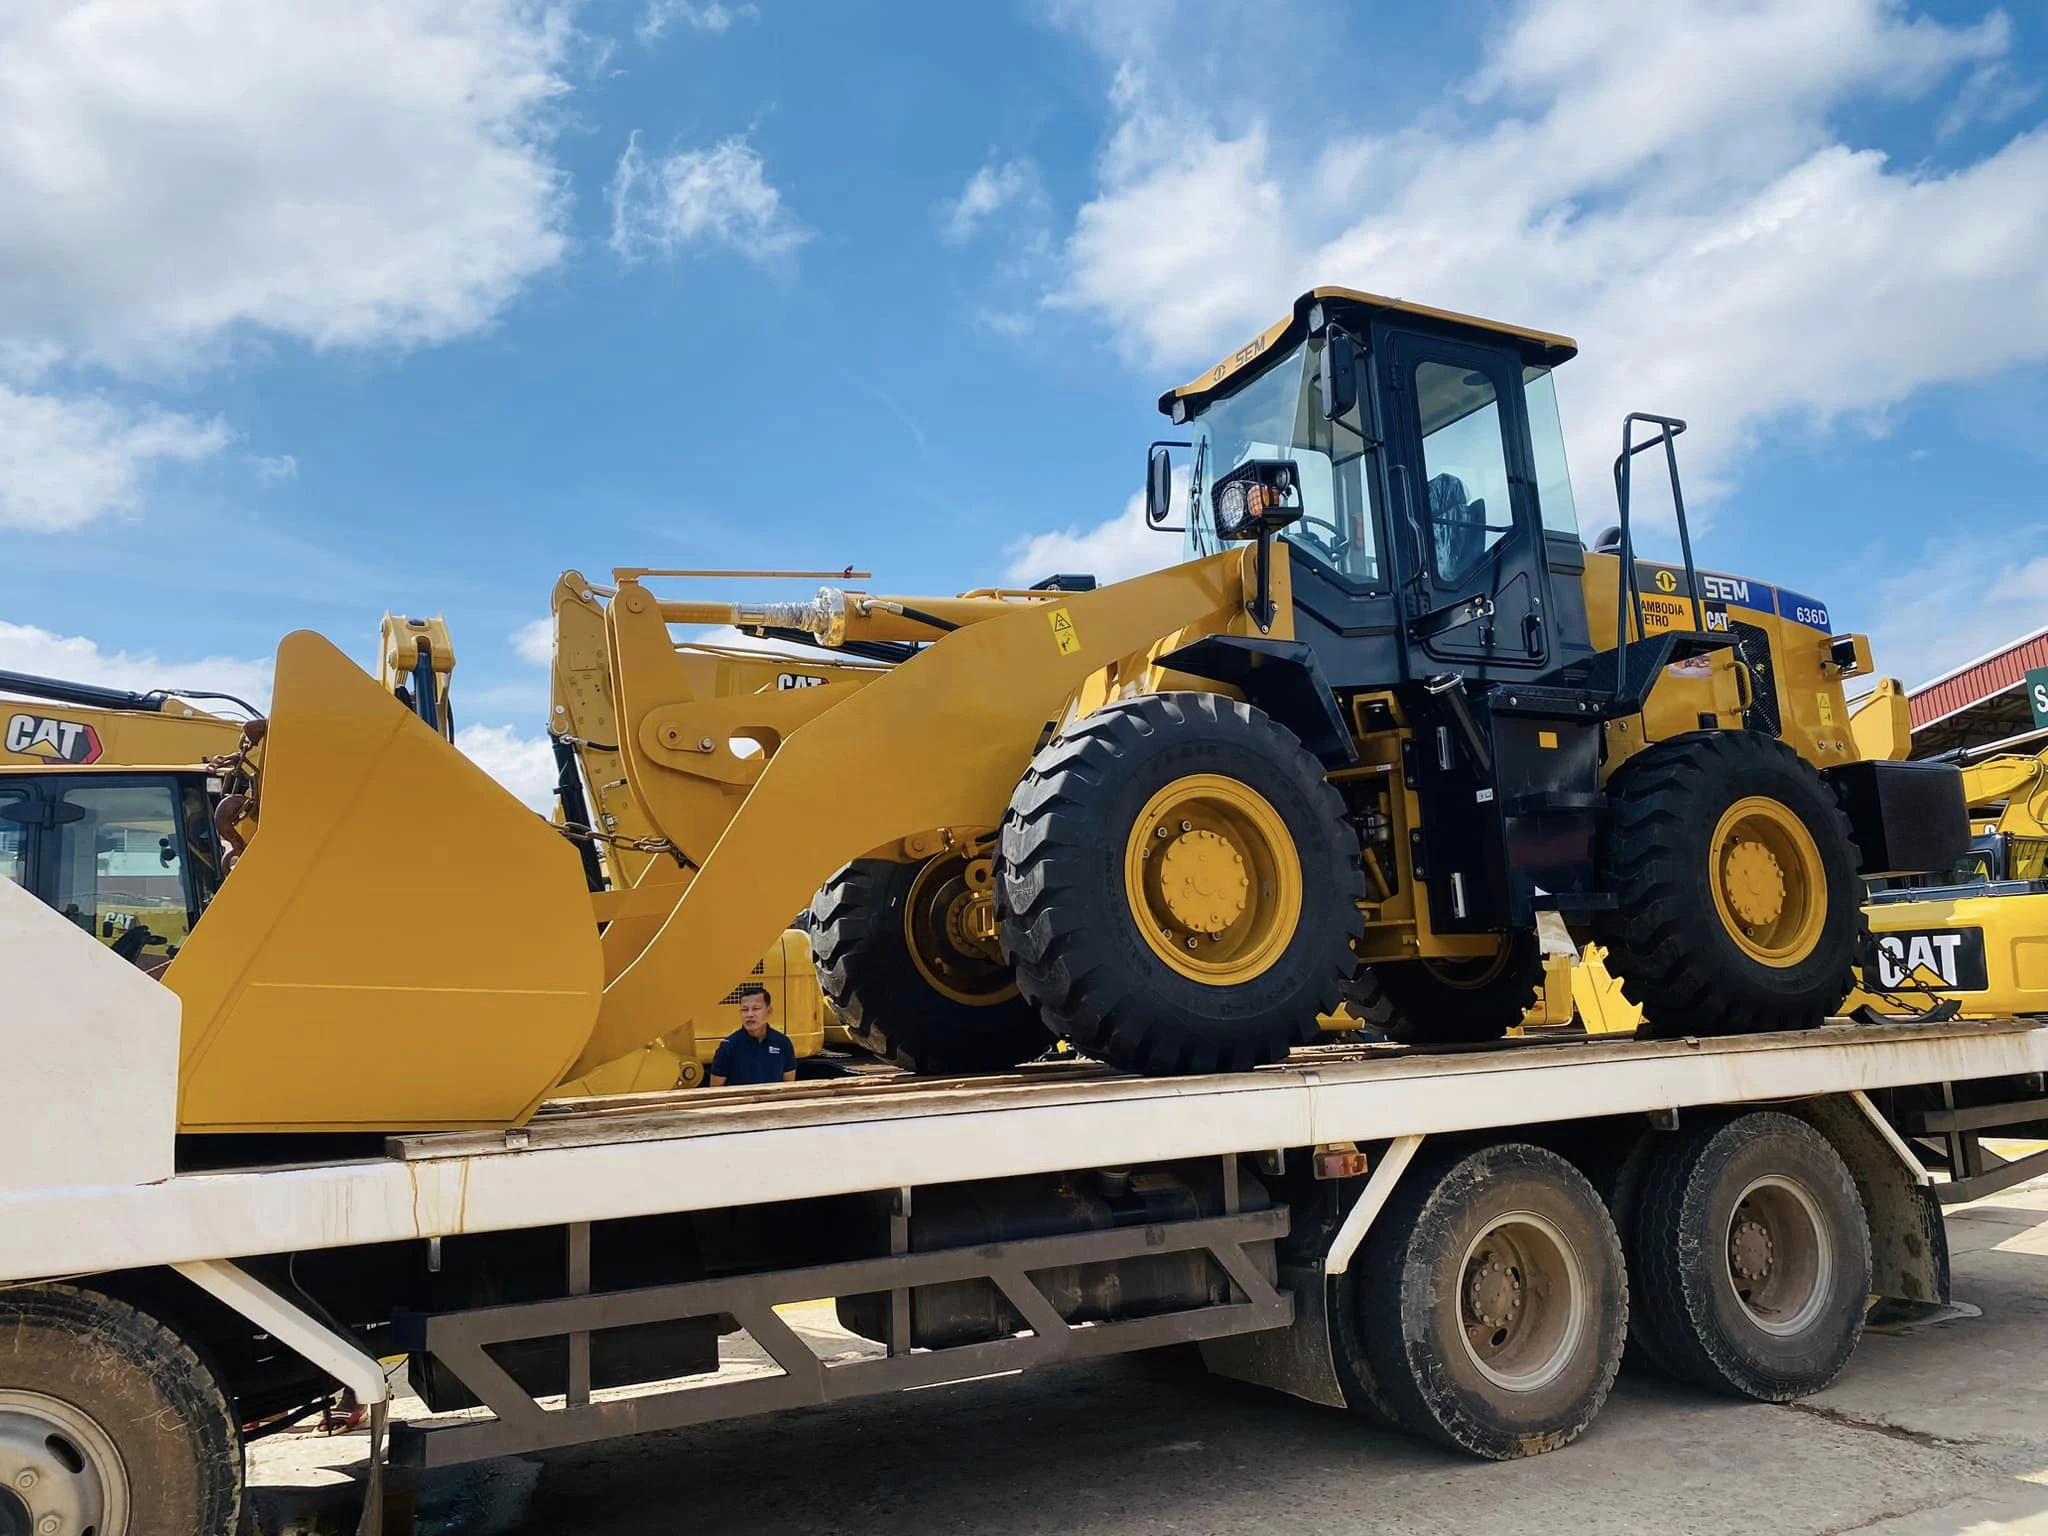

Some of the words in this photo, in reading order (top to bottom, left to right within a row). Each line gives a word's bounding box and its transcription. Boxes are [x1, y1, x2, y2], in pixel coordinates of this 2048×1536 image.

[1235, 335, 1265, 368] SEM
[1703, 576, 1750, 602] SEM
[1641, 600, 1685, 616] AMBODIA
[1796, 607, 1828, 625] 636D
[1644, 613, 1669, 627] ETRO
[1706, 611, 1728, 632] CAT
[6, 714, 84, 760] CAT
[1878, 934, 1961, 988] CAT
